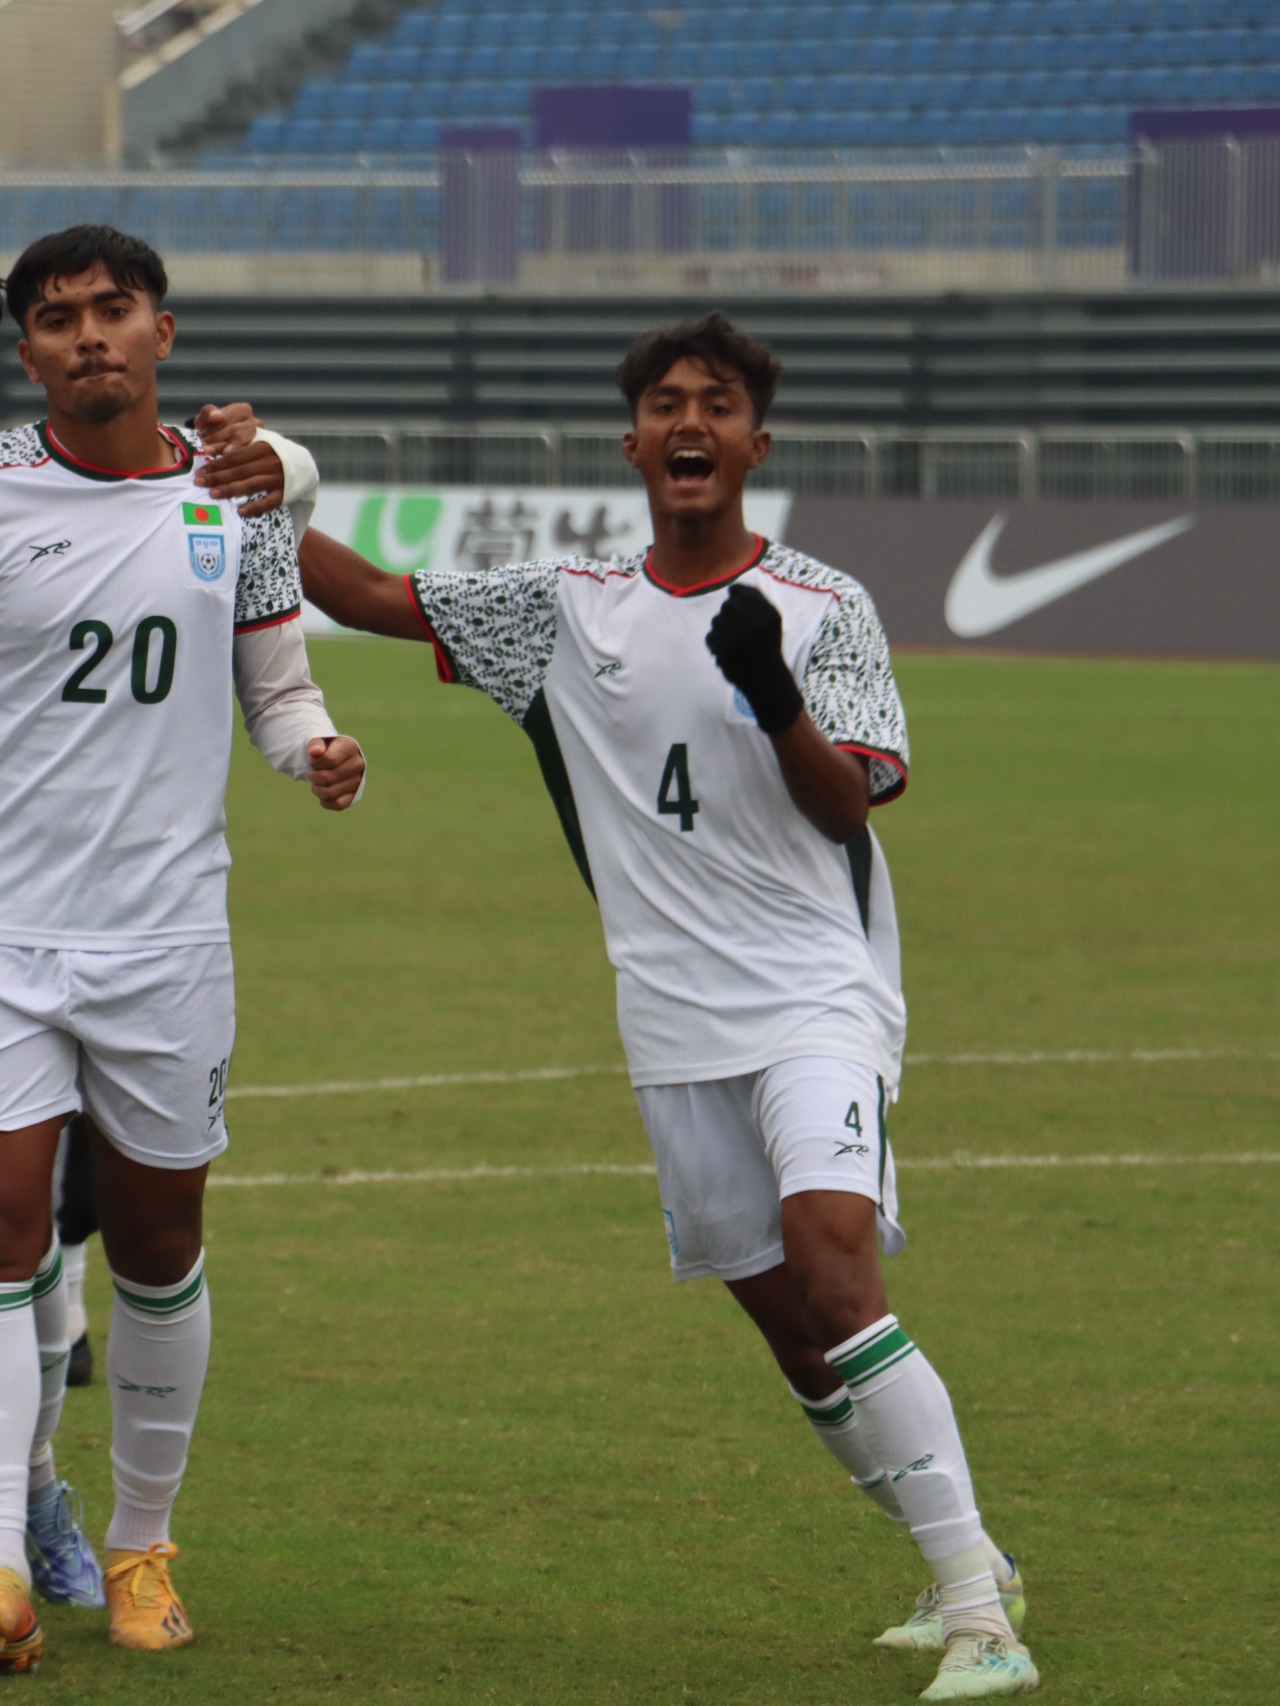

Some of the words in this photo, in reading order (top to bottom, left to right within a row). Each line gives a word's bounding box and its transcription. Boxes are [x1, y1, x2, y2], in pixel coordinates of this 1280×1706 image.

[61, 615, 177, 705] 20
[657, 743, 699, 832] 4
[207, 1058, 226, 1107] 20
[844, 1101, 862, 1138] 4
